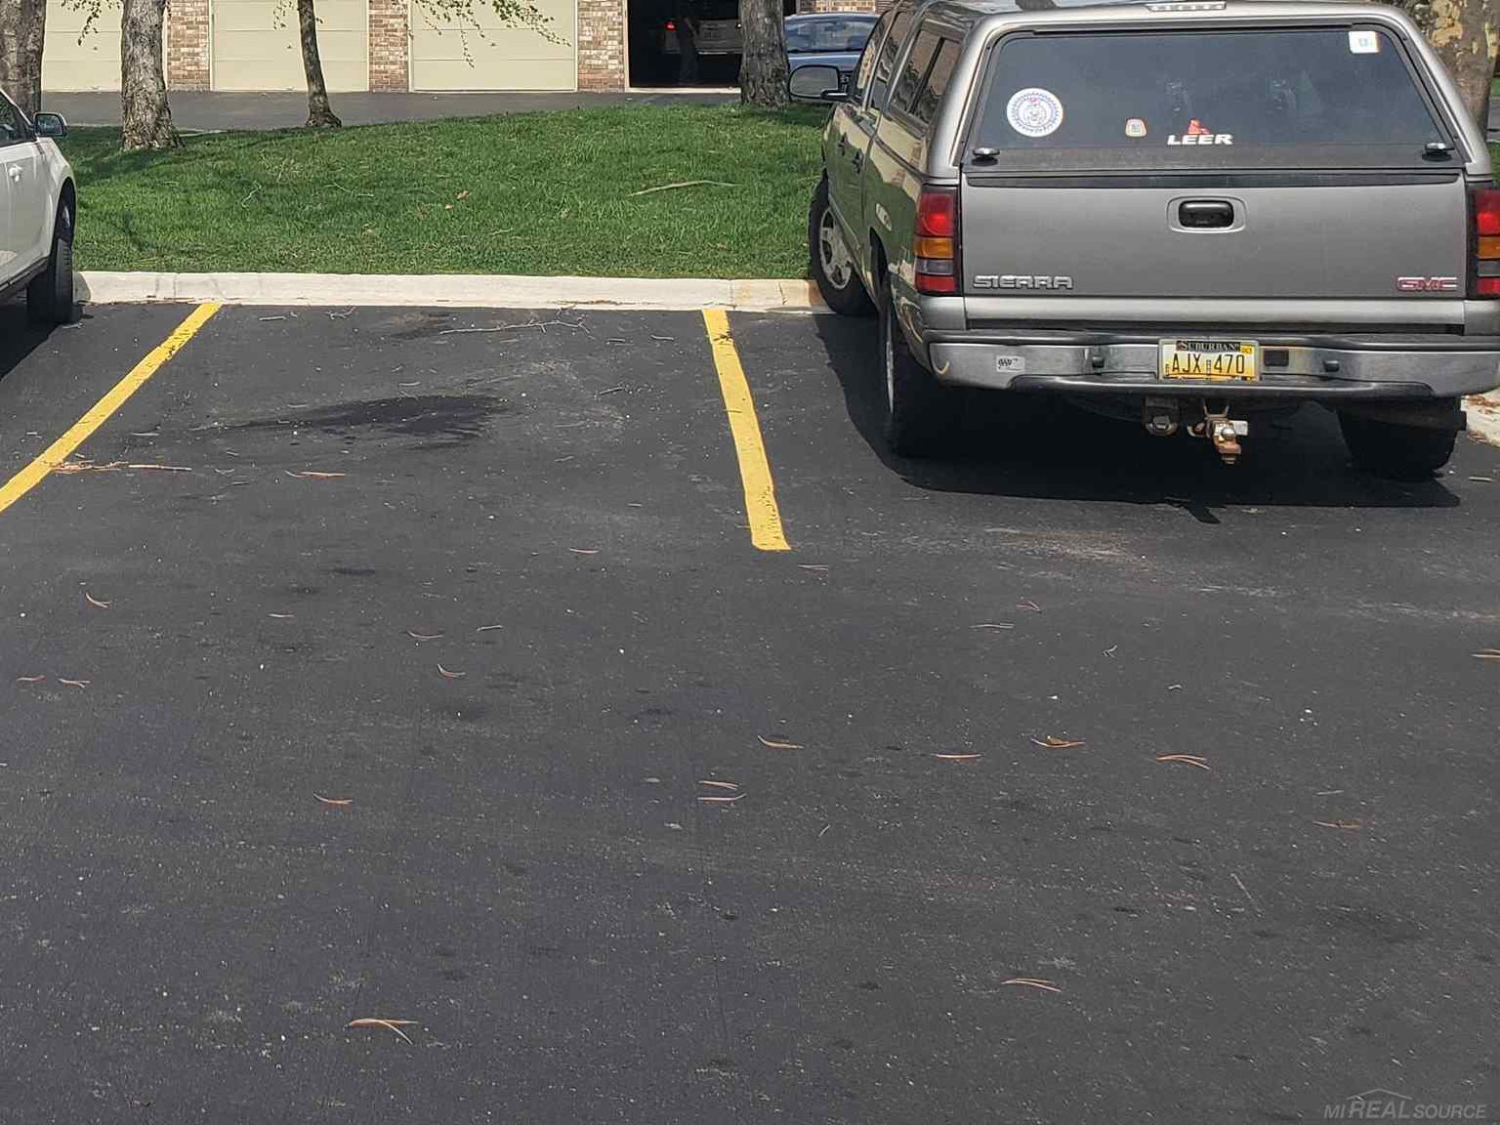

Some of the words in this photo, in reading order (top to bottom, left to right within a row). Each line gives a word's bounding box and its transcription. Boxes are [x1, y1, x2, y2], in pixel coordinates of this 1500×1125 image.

[1167, 134, 1233, 145] LEER
[972, 275, 1073, 289] SIERRA
[1397, 276, 1458, 291] GMC
[1172, 353, 1201, 373] AJX
[1214, 354, 1245, 374] 470
